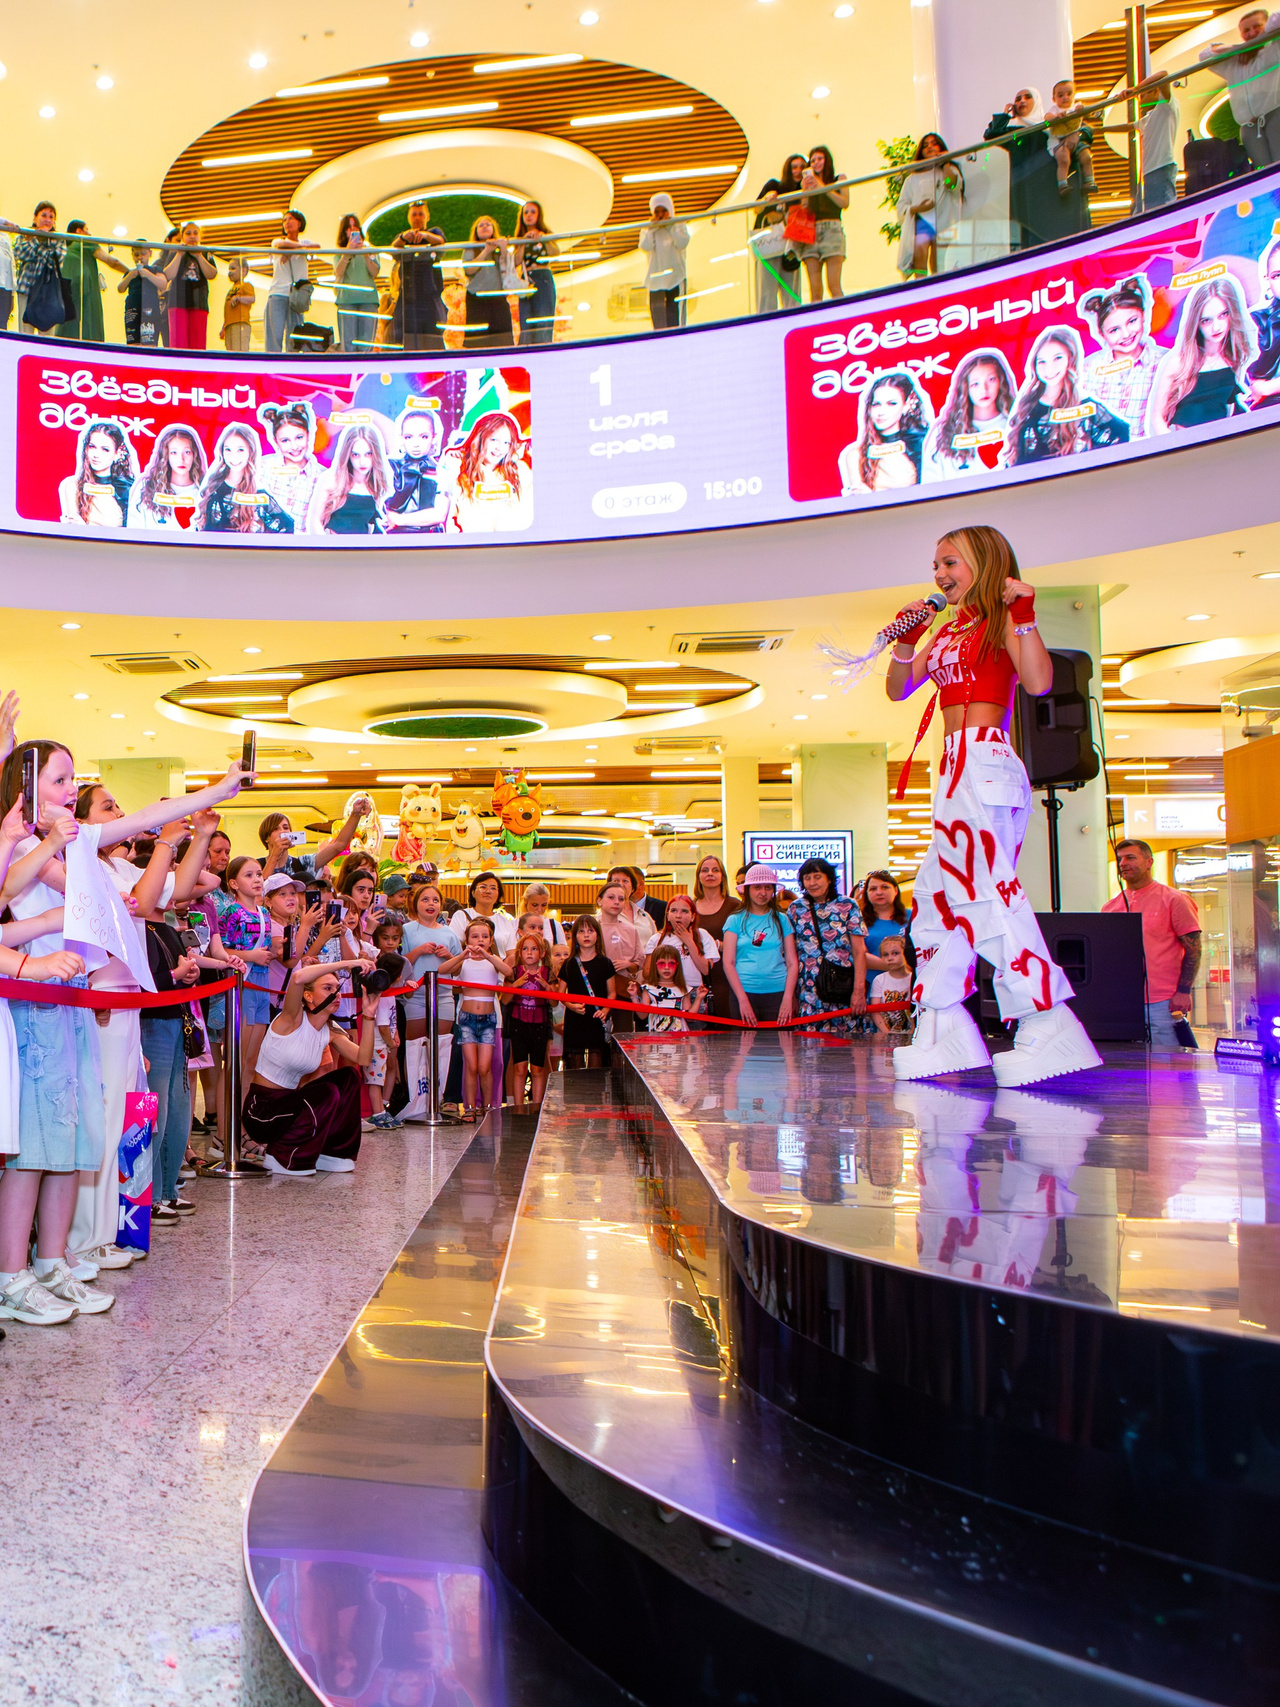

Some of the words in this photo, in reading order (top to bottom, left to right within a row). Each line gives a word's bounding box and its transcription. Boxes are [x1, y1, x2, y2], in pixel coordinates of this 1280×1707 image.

[810, 276, 1075, 363] Звёздный
[39, 369, 257, 410] Звёздный
[590, 363, 612, 406] 1
[589, 410, 669, 432] июля
[589, 433, 675, 459] среда
[604, 497, 615, 509] 0
[622, 493, 673, 508] этаж
[703, 476, 763, 501] 15:00
[776, 843, 840, 851] УНИВЕРСИТЕТ
[776, 851, 840, 860] СИНЕРГИЯ
